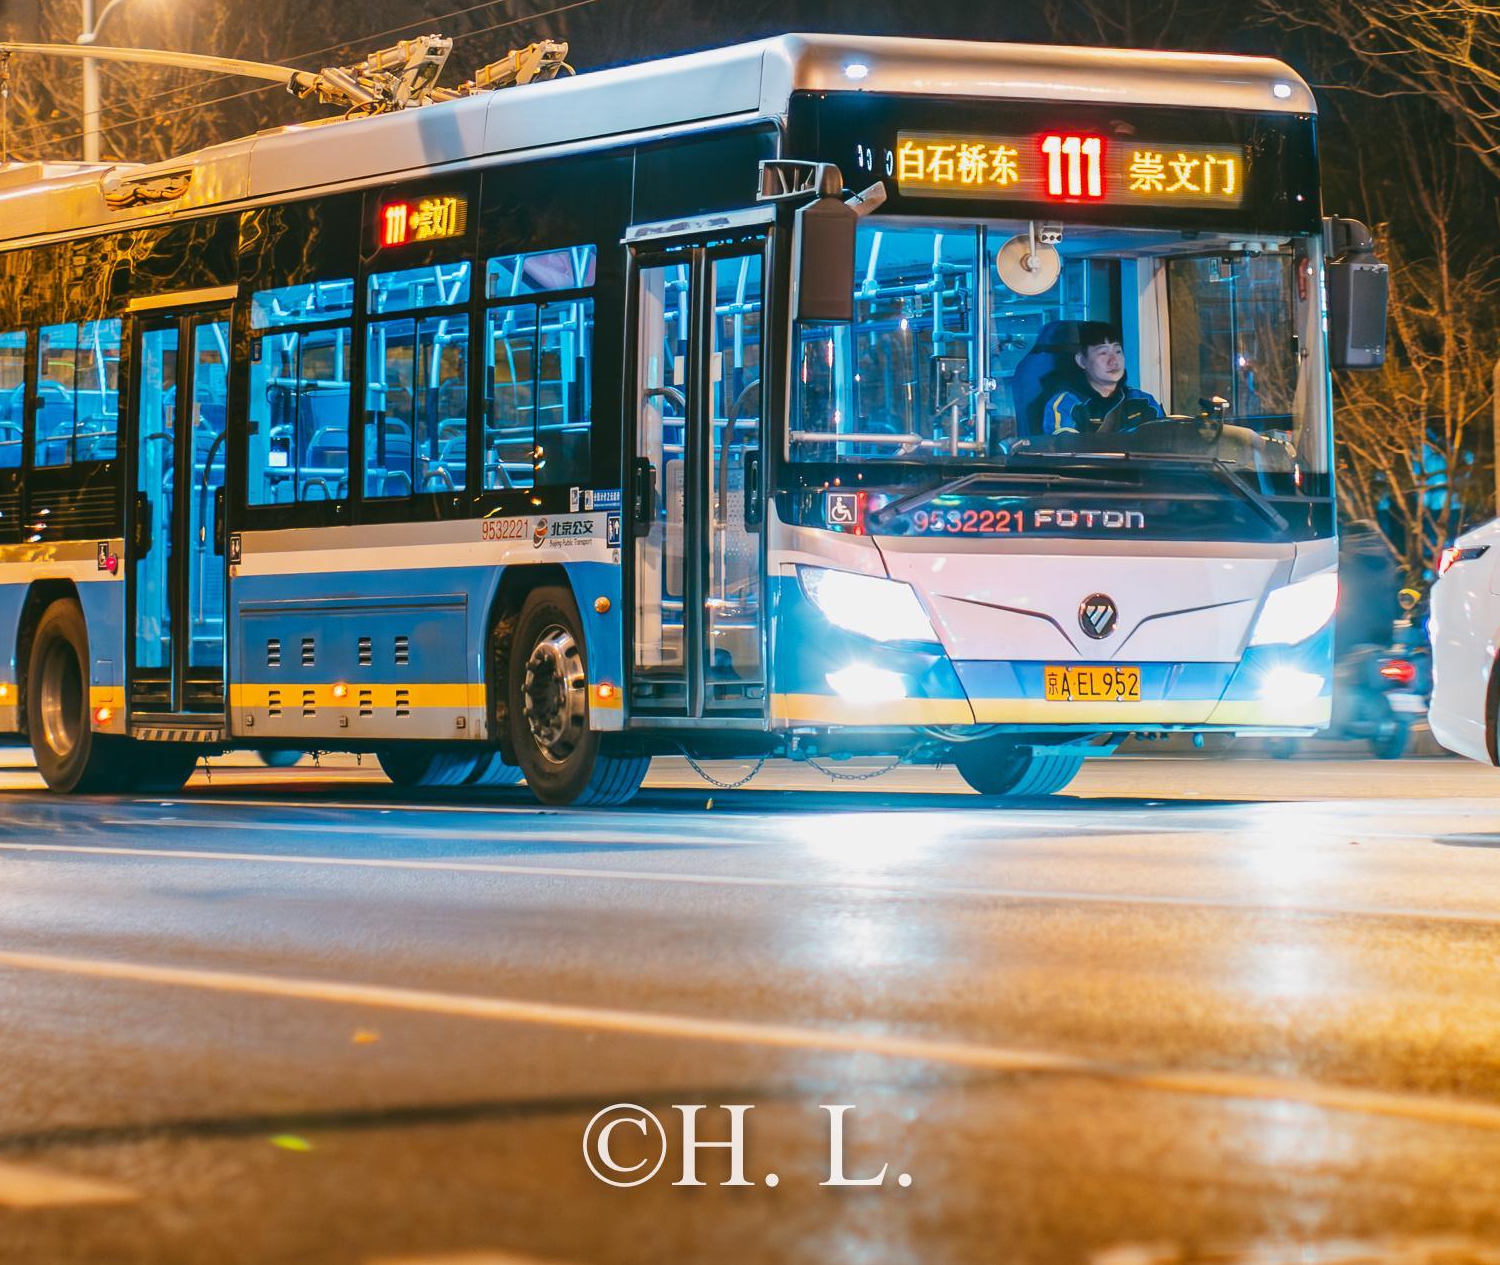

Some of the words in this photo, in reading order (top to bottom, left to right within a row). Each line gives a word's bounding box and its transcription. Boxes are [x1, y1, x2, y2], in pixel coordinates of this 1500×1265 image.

[899, 141, 1019, 185] 白石桥东
[1041, 136, 1102, 196] 111
[1129, 151, 1234, 193] 崇文门
[386, 204, 407, 244] 111
[482, 519, 529, 540] 9532221
[551, 520, 594, 536] 北京公交
[914, 510, 1024, 533] 9532221
[1035, 509, 1145, 528] FOTON
